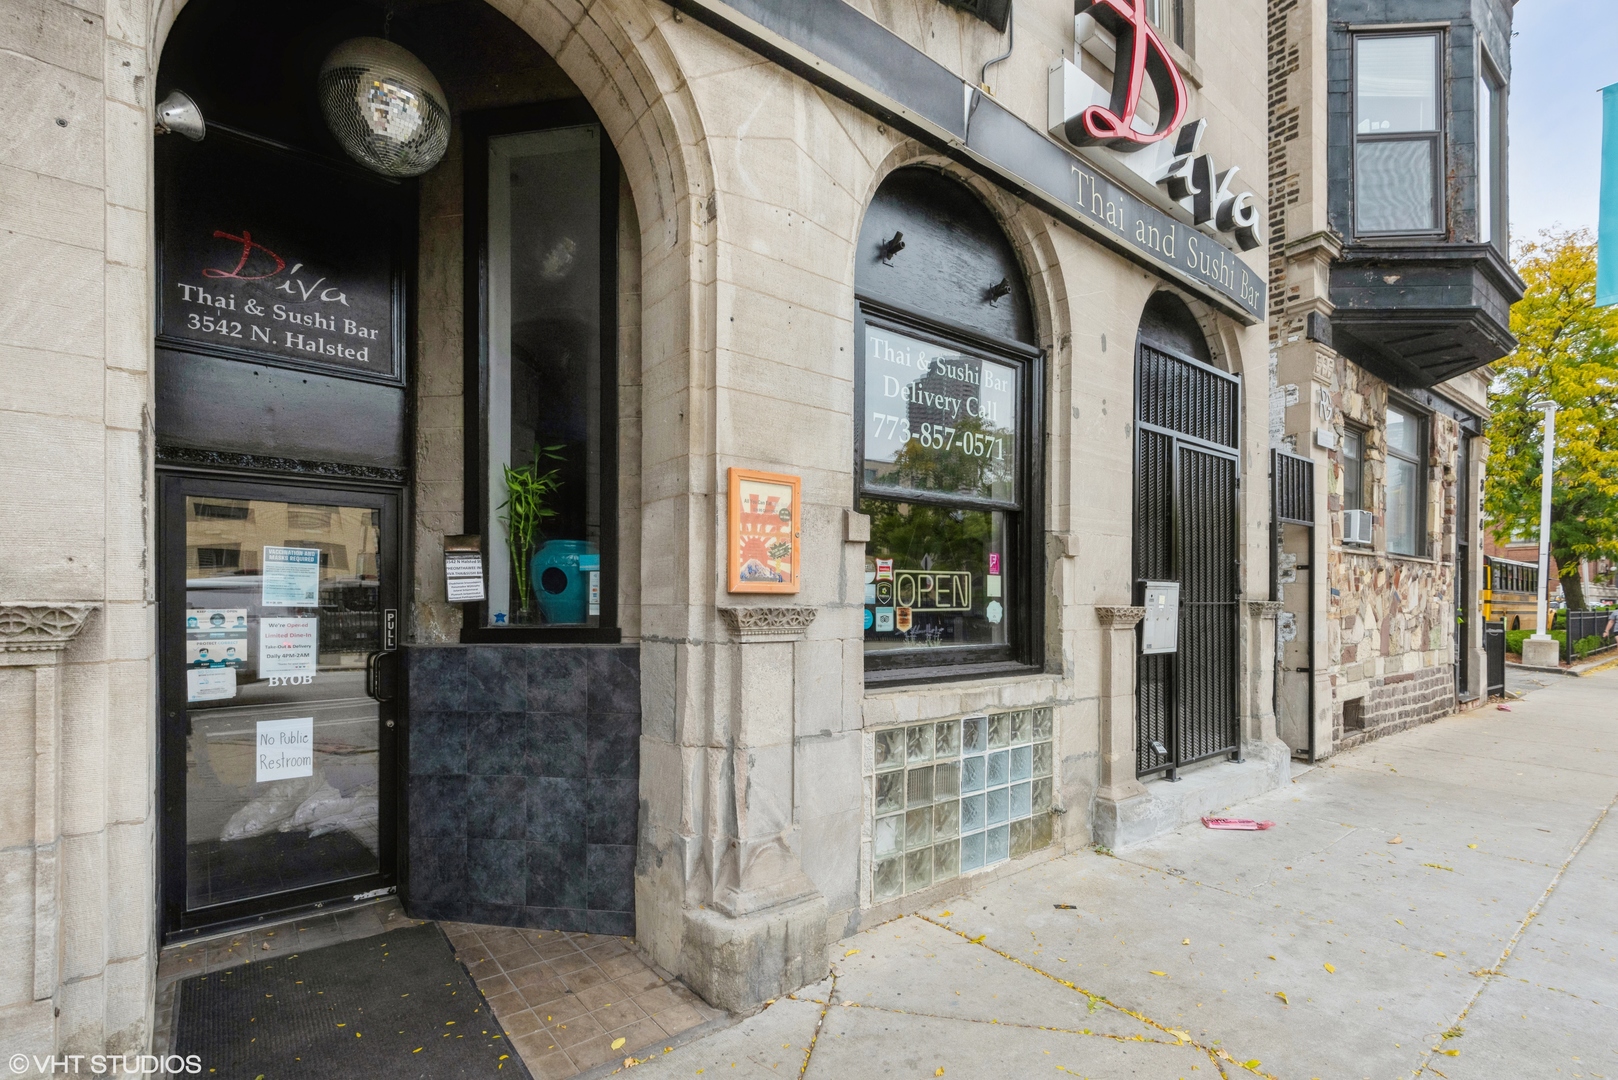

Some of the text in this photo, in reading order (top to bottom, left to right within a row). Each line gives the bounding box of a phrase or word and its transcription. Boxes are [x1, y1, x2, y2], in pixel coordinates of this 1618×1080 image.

[1071, 164, 1260, 311] Thai and Sushi Bar
[177, 282, 379, 340] Thai & Sushi Bar
[187, 313, 370, 363] 3542 N. Halsted
[870, 336, 1008, 393] Thai & Sushi Bar
[883, 374, 998, 422] Delivery Call
[872, 412, 1005, 461] 773-857-0571
[897, 573, 968, 608] OPEN
[268, 675, 313, 687] BYOB
[259, 752, 311, 770] Restroom
[260, 731, 309, 746] No Public
